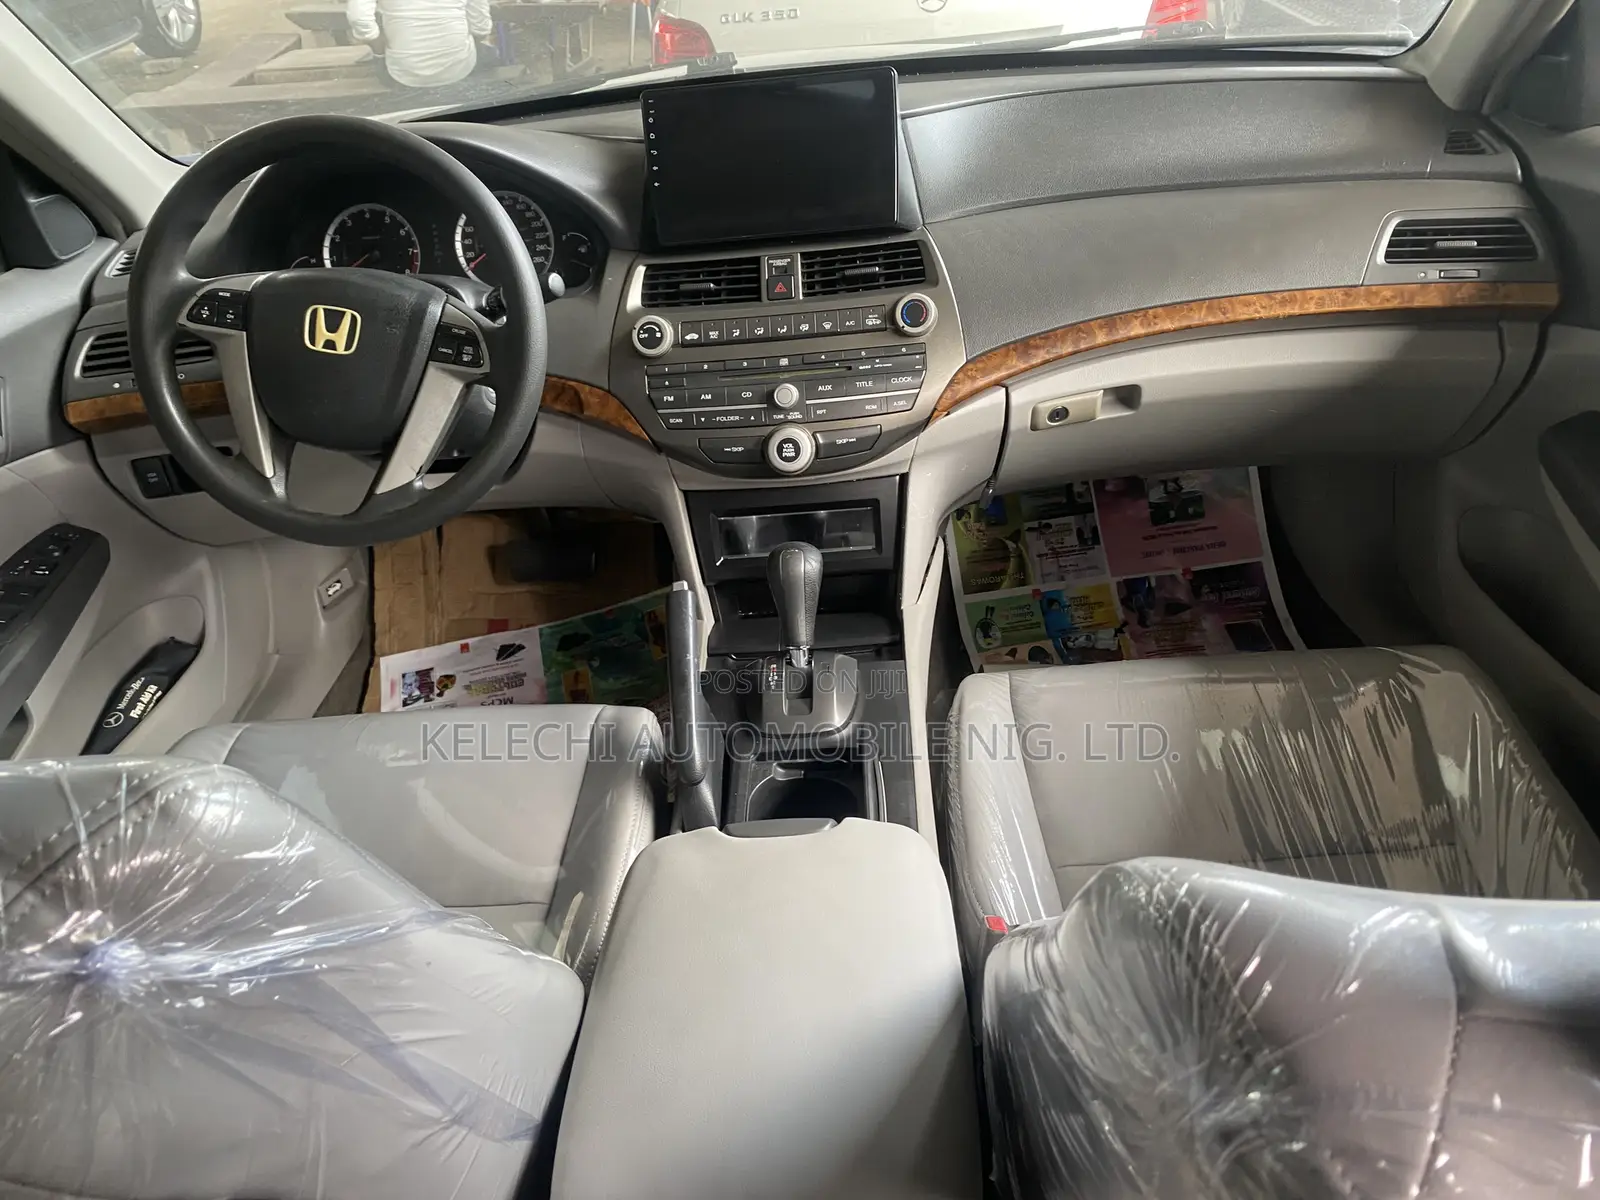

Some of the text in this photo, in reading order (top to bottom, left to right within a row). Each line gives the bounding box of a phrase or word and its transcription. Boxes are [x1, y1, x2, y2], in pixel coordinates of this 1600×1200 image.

[720, 8, 799, 24] GLK 350
[856, 380, 874, 388] TITLE
[891, 375, 913, 384] CLOCK
[129, 701, 146, 719] First
